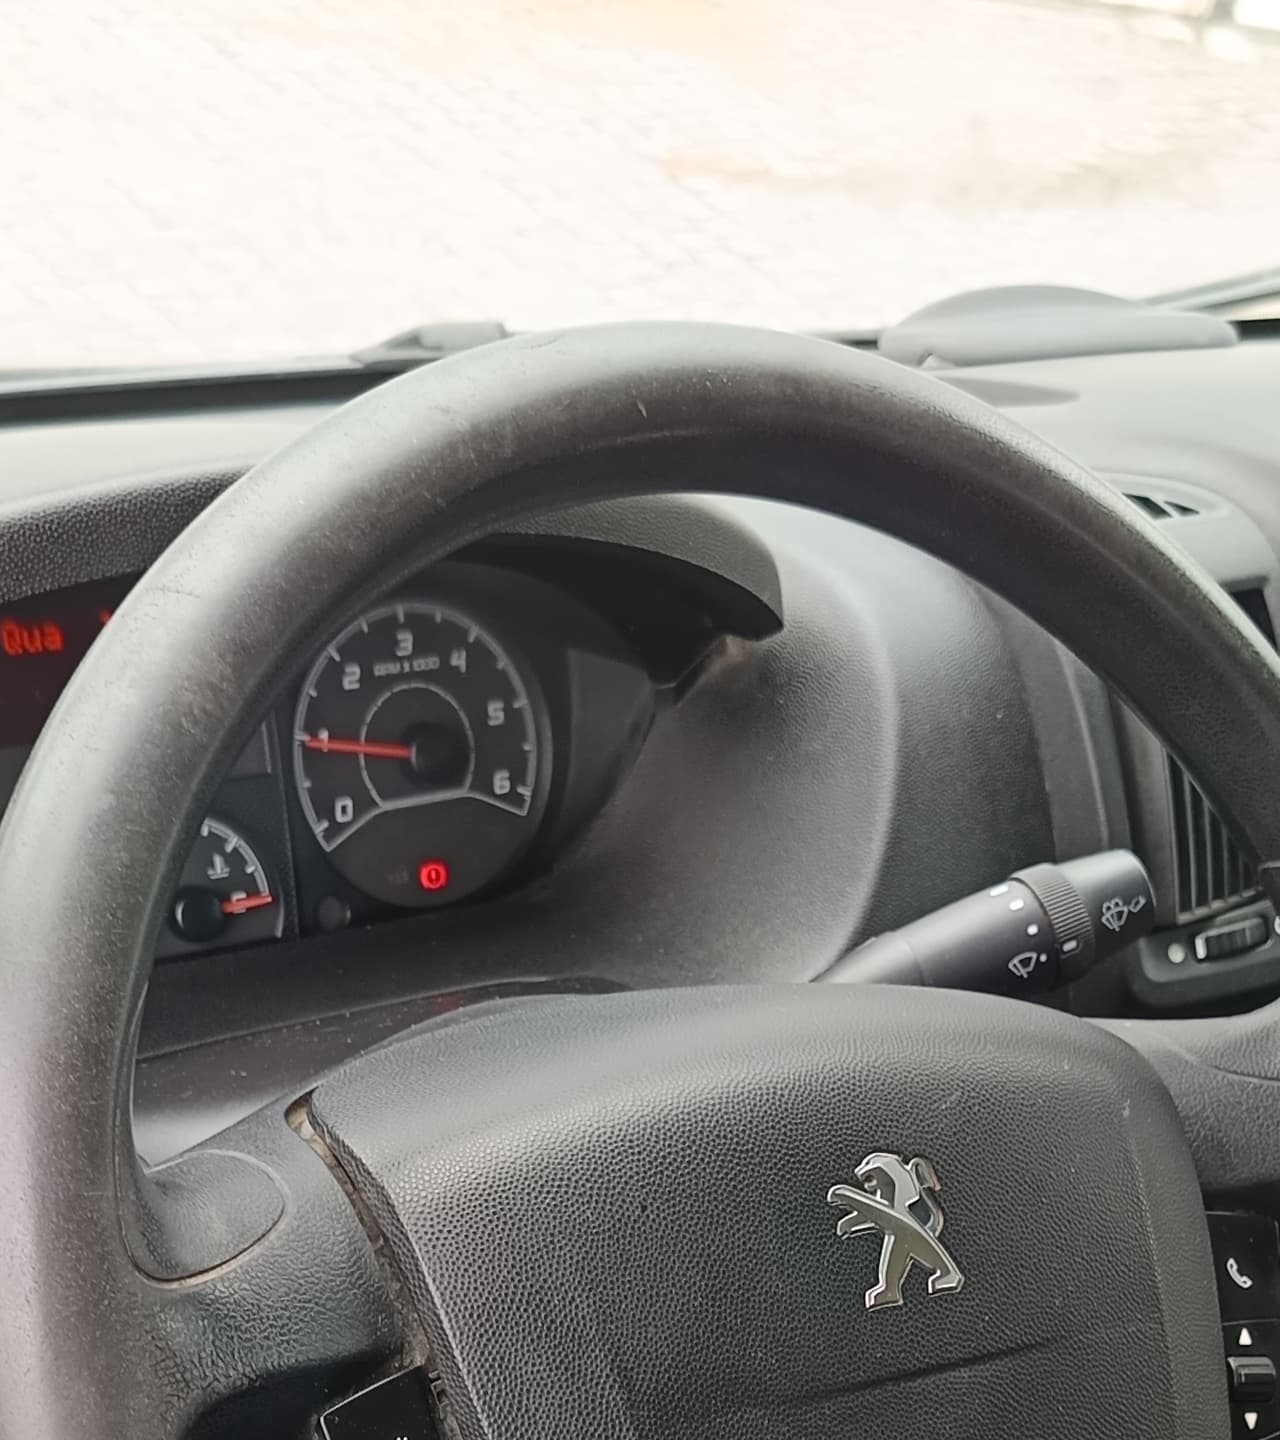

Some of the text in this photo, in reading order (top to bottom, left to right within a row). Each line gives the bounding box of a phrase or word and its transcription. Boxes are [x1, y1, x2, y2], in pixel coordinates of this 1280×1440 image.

[0, 617, 63, 656] Qua
[395, 630, 413, 656] 3
[450, 648, 466, 672] 4
[342, 662, 360, 689] 2
[487, 700, 504, 725] 5
[493, 769, 510, 795] 6
[335, 797, 353, 823] 0
